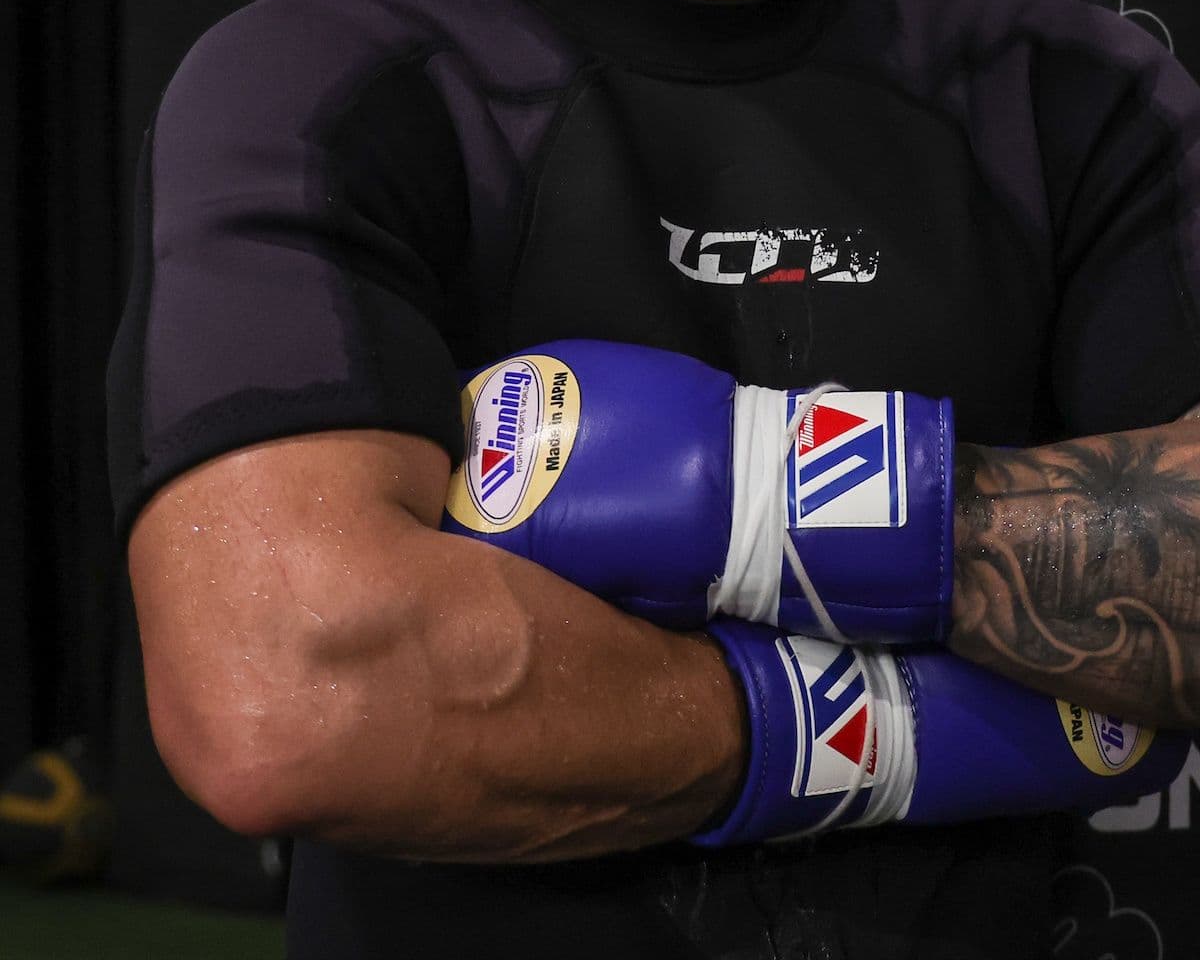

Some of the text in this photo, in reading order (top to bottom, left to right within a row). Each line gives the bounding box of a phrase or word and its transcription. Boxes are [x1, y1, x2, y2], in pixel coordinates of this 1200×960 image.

[518, 409, 527, 435] SPORTS
[520, 385, 530, 408] WORLD
[545, 371, 568, 472] Made in JAPAN
[481, 371, 532, 503] Winning
